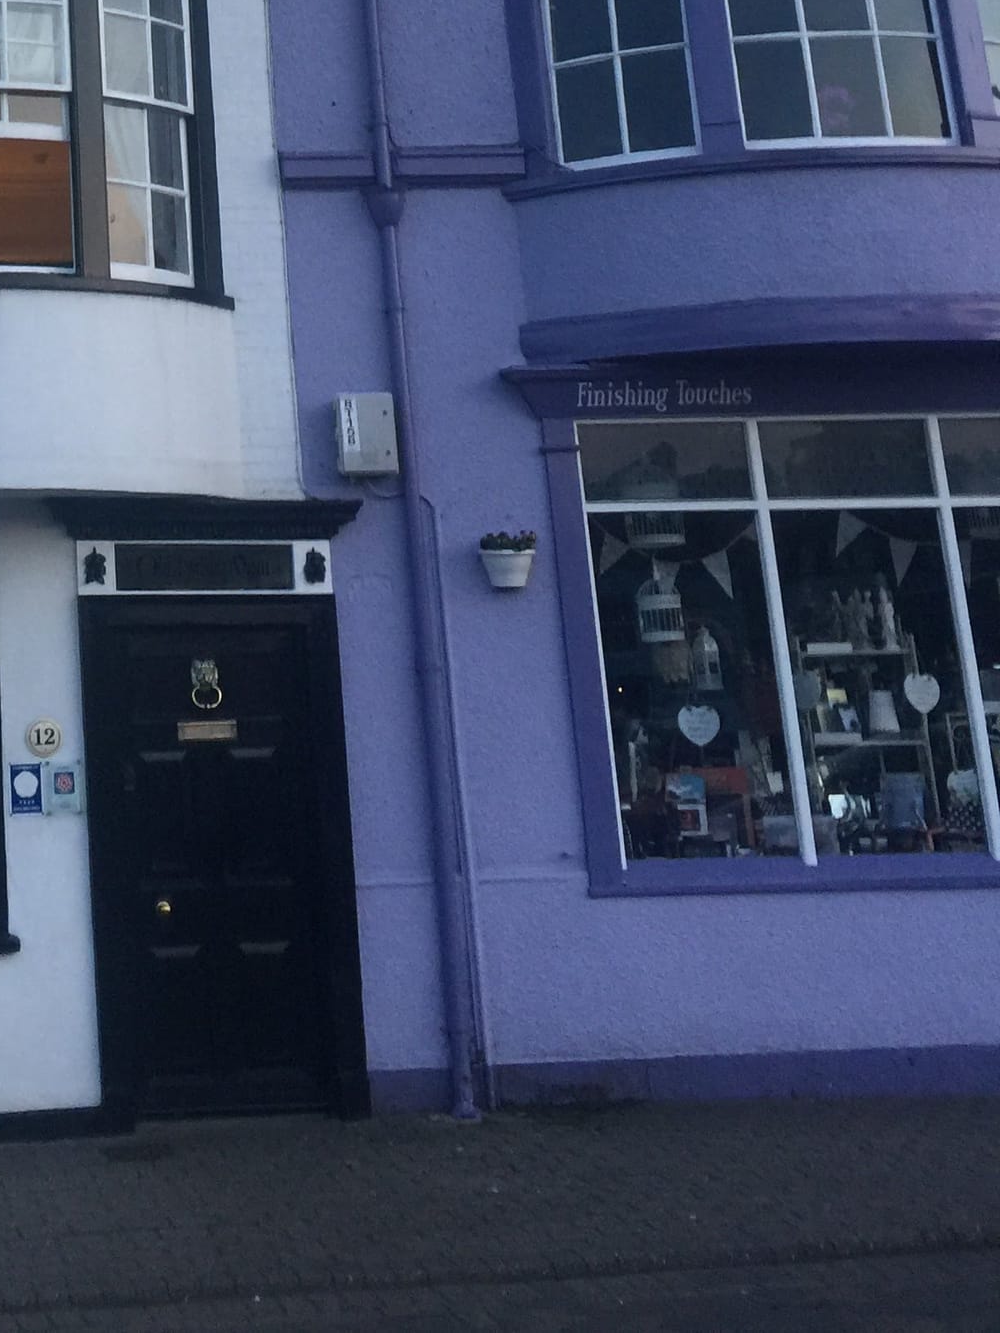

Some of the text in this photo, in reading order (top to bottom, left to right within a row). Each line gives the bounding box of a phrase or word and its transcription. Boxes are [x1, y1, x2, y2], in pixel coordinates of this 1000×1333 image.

[576, 379, 752, 412] Finishing Touches
[34, 728, 55, 746] 12
